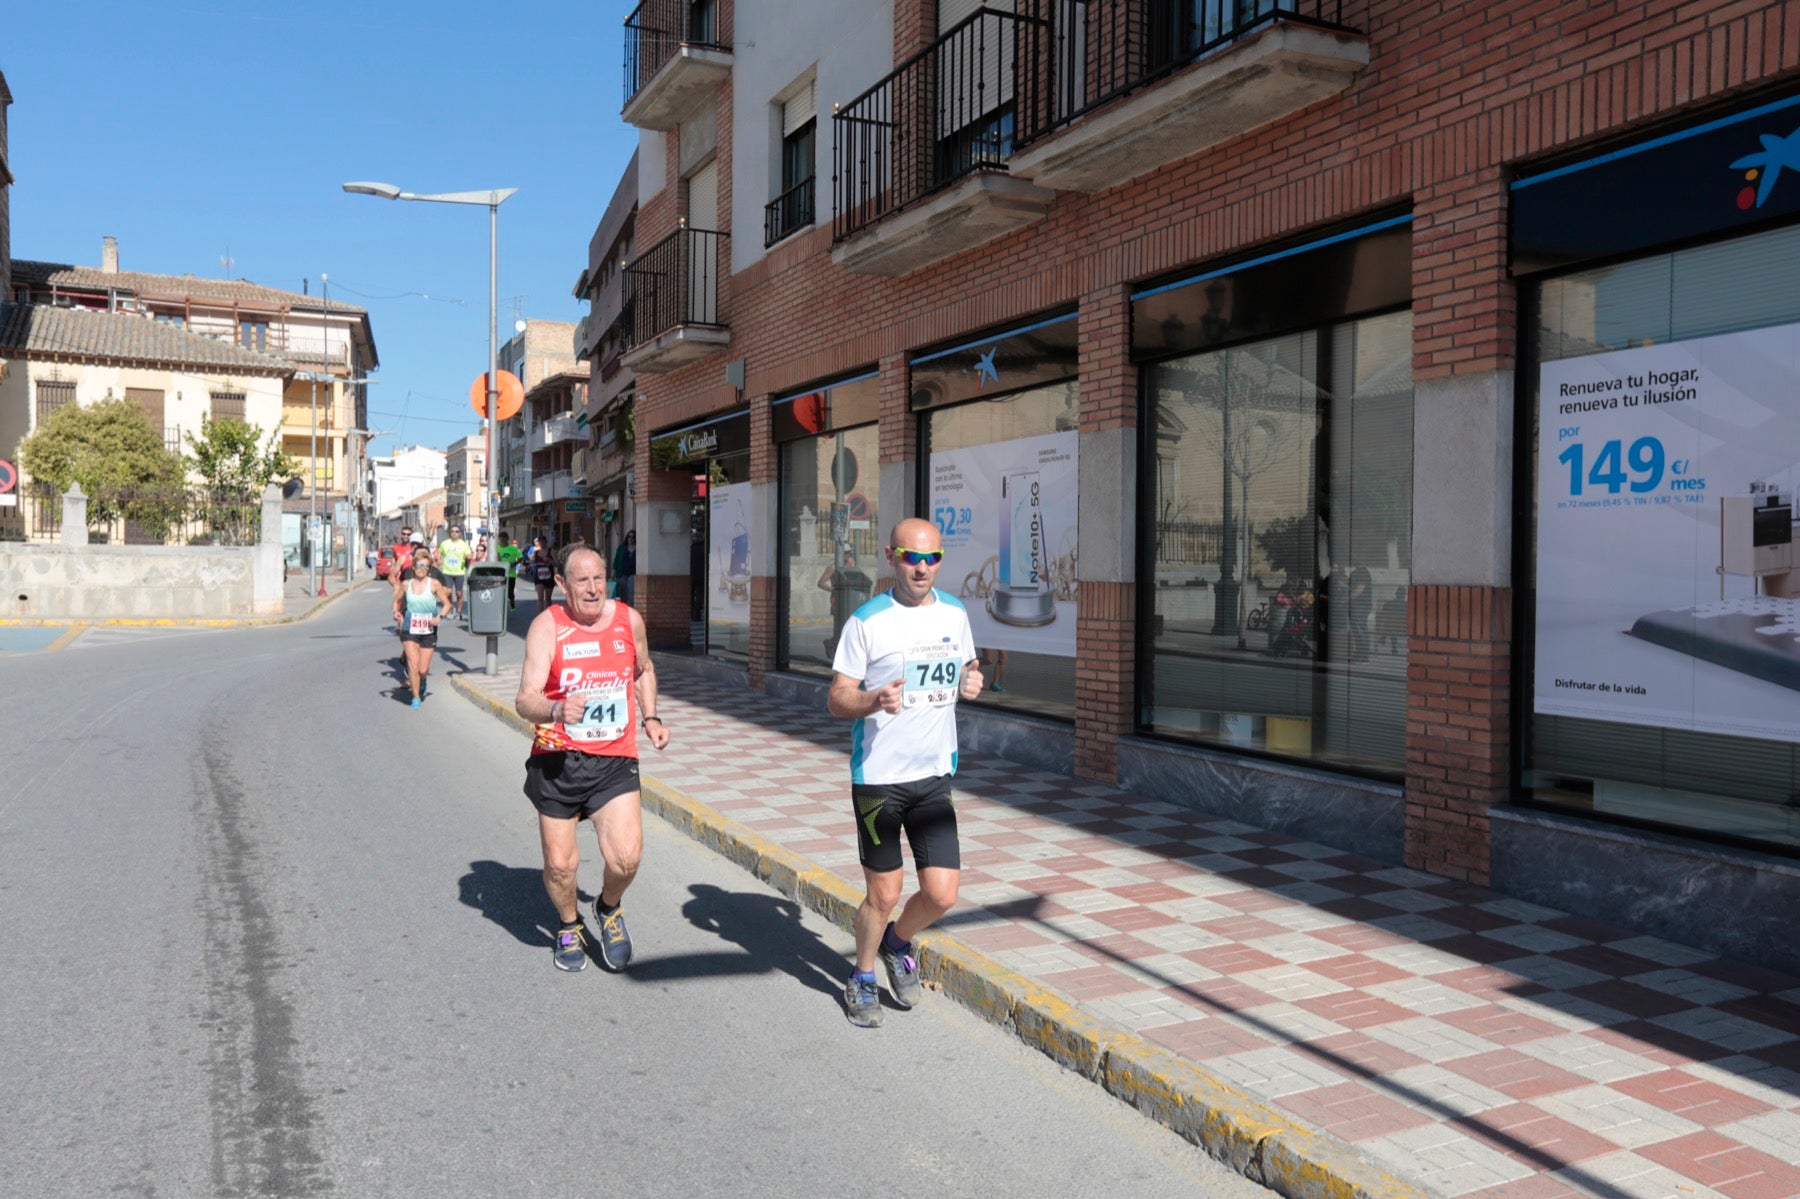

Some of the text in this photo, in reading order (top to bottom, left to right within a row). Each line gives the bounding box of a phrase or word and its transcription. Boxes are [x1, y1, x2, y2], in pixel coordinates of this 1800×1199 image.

[1560, 368, 1699, 397] Renueva tu hogar,
[1559, 386, 1696, 414] renueva tu ilusión
[1559, 426, 1581, 440] por
[1558, 436, 1665, 496] 149
[1031, 481, 1040, 507] 5G
[1671, 478, 1705, 491] mes
[1030, 513, 1039, 584] Note10+
[917, 662, 955, 686] 749
[1555, 679, 1647, 695] Disfrutar de la vida
